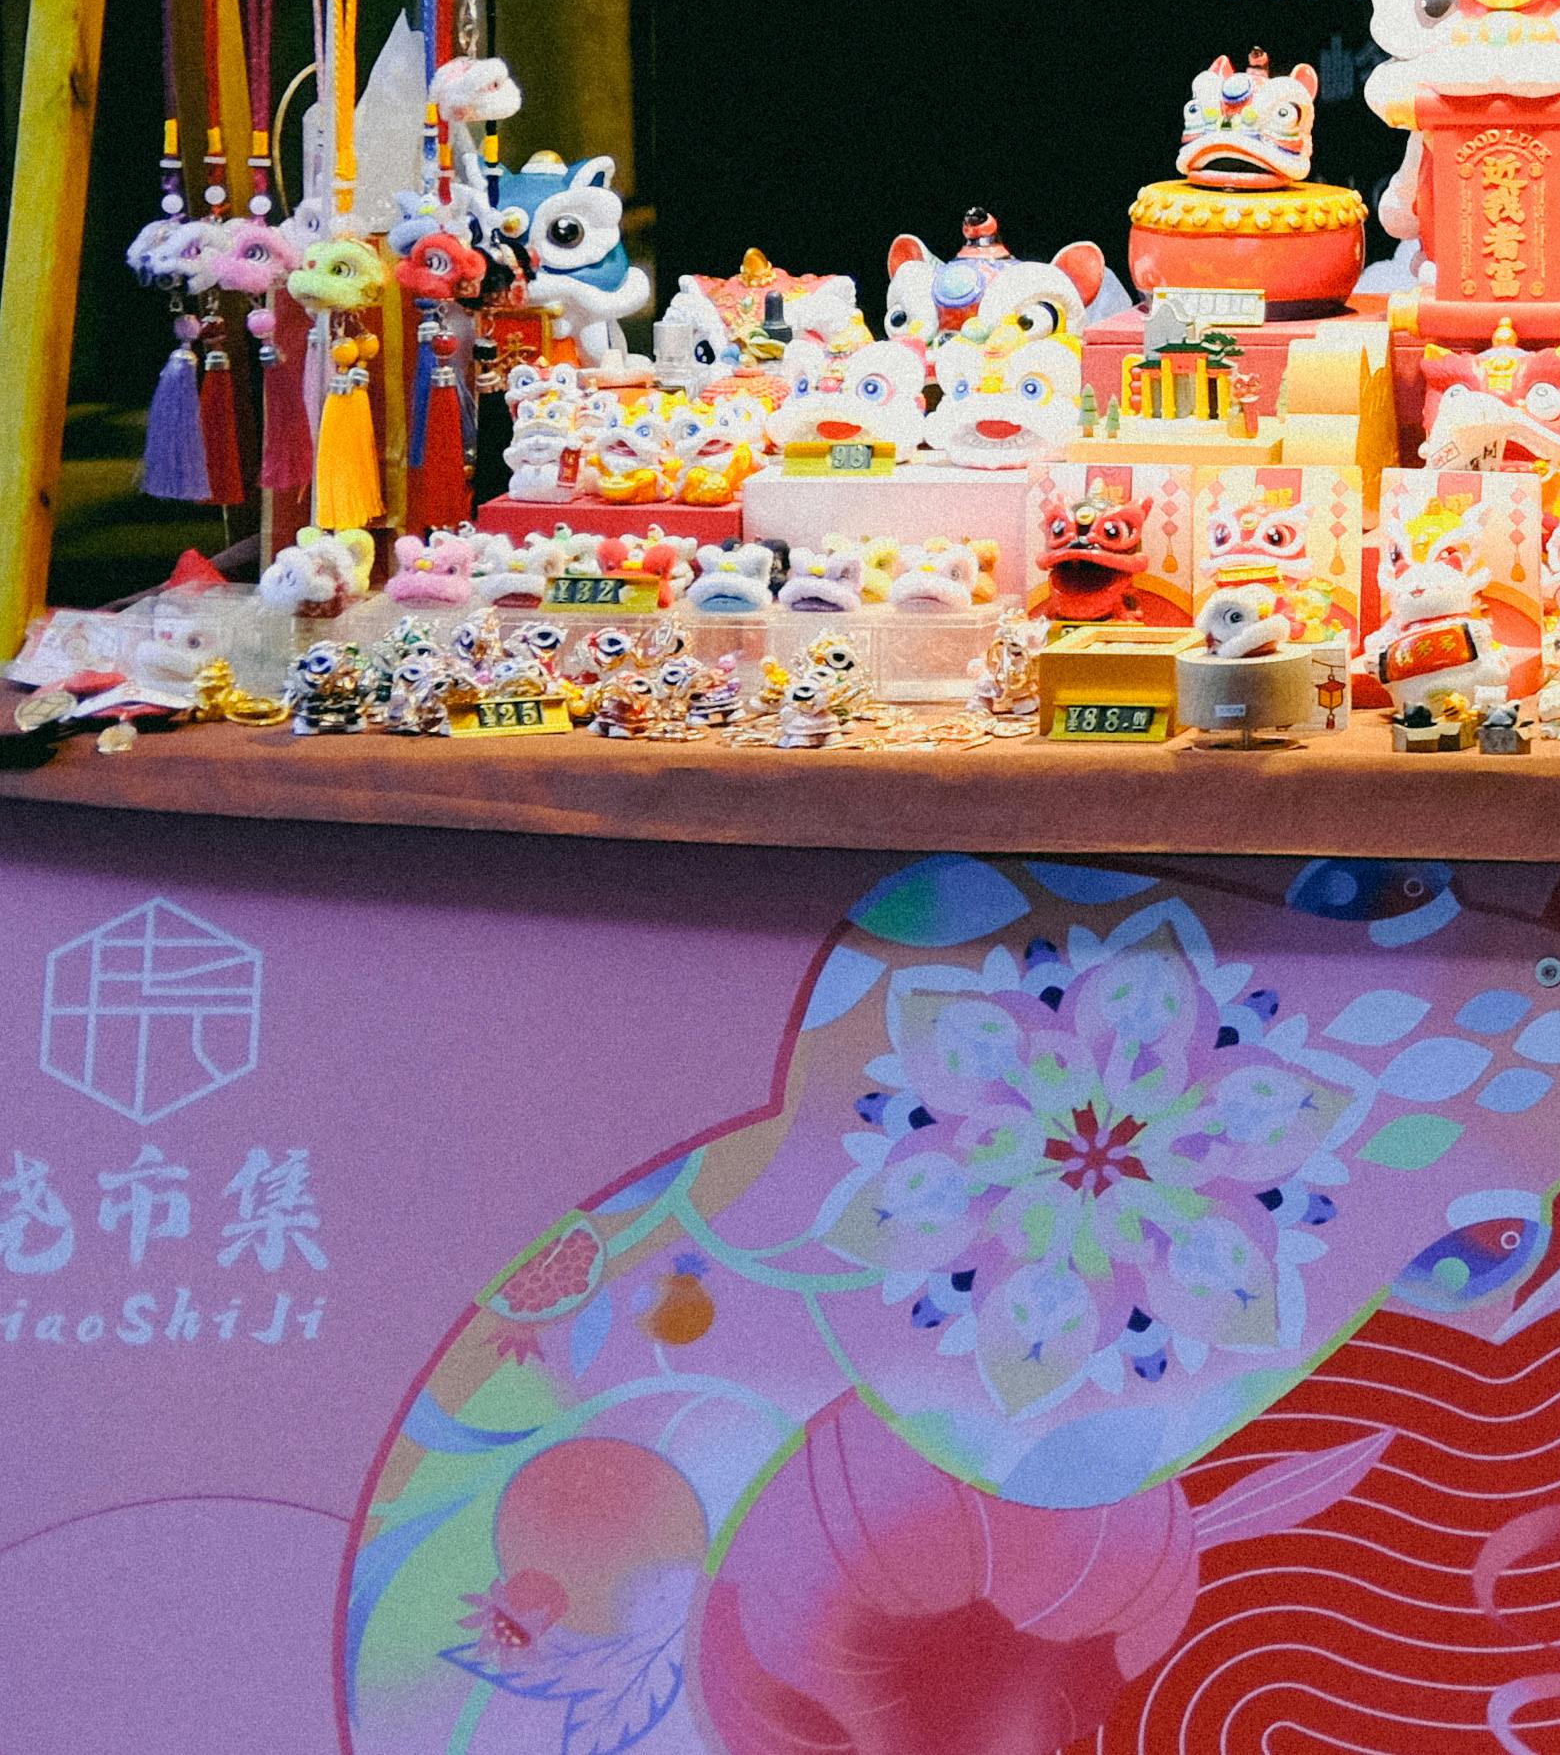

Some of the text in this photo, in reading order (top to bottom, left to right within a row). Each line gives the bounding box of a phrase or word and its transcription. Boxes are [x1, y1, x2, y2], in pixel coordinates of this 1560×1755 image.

[1455, 129, 1552, 163] GOOD LUCK
[556, 579, 616, 602] ¥32
[480, 702, 538, 727] ¥25
